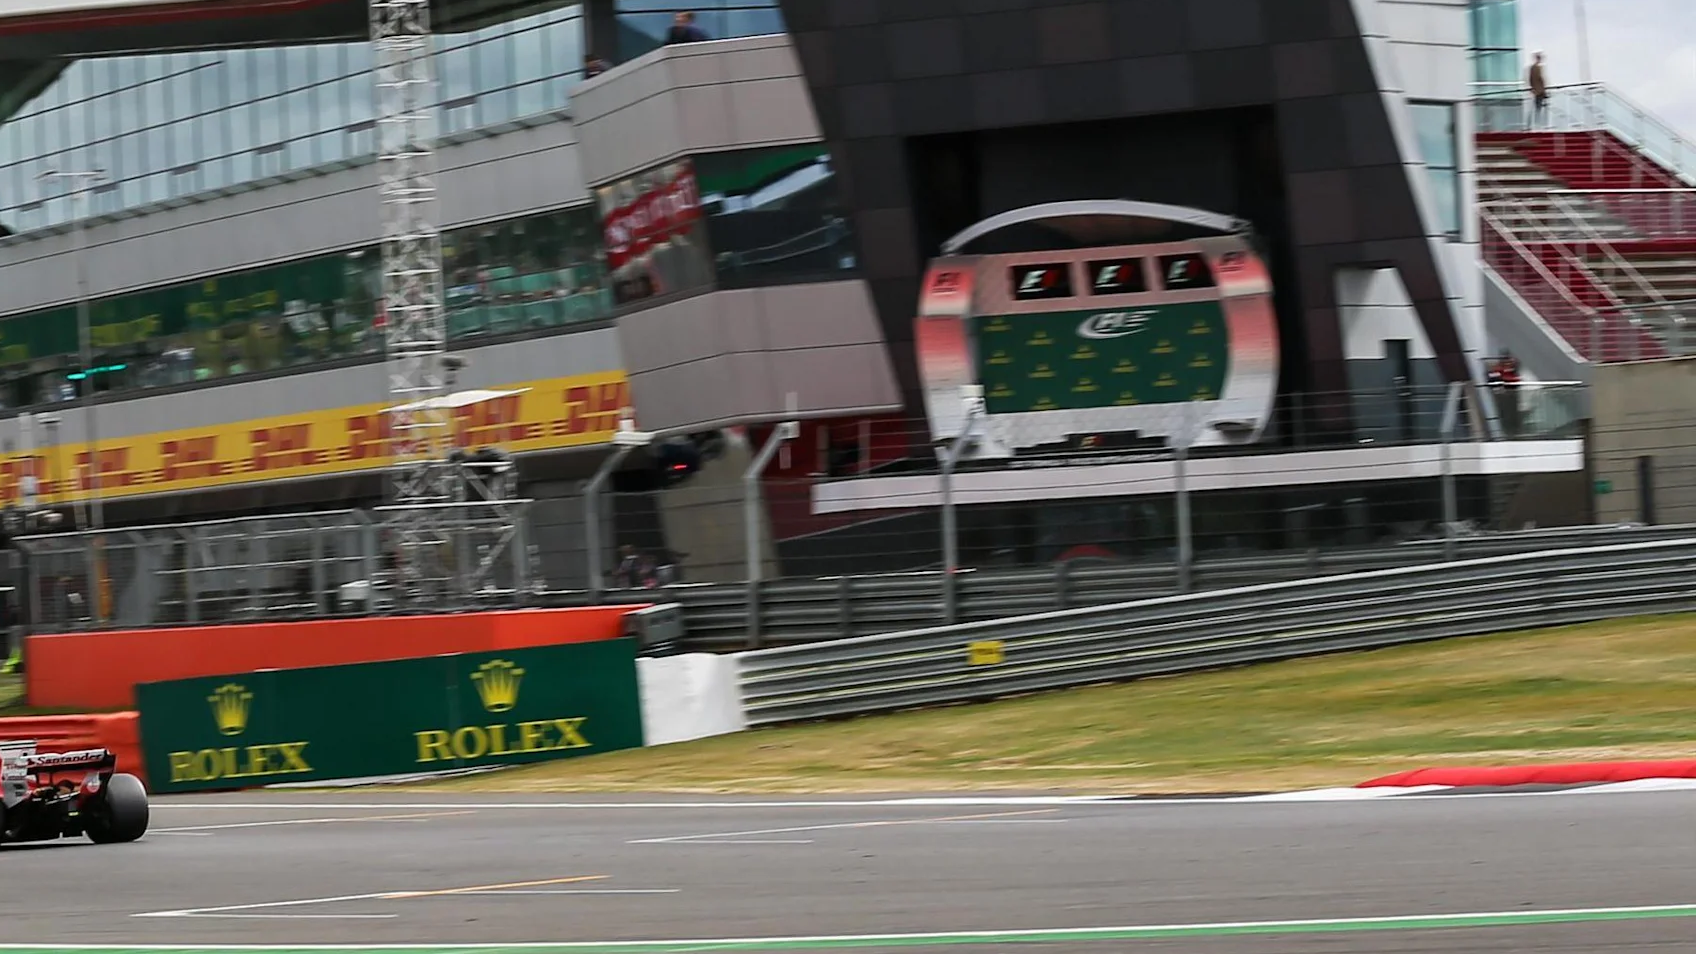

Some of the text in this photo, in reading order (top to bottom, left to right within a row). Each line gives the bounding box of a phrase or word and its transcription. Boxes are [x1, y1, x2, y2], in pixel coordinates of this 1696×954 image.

[37, 752, 103, 765] Santander
[413, 716, 593, 762] ROLEX
[168, 741, 314, 782] ROLEX
